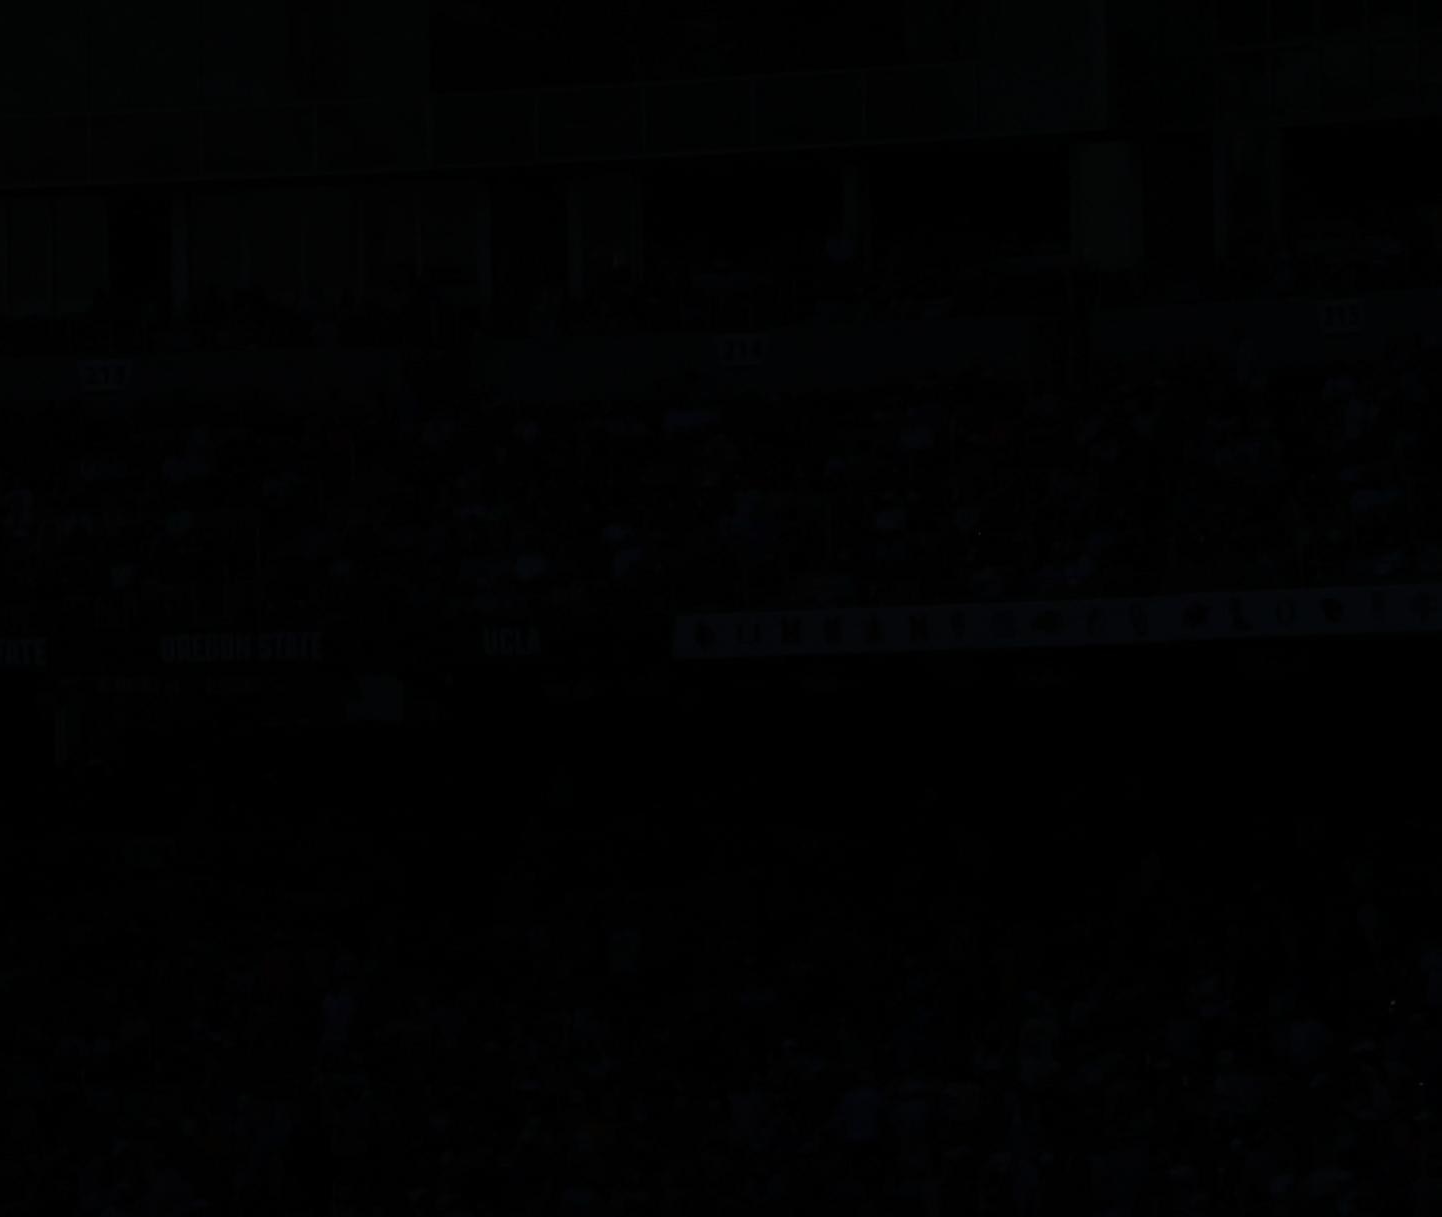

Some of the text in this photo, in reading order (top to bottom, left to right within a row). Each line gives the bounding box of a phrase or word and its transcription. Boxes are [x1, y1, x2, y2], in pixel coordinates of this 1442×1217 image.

[159, 631, 324, 665] OREGON STATE
[482, 625, 542, 656] UCLA
